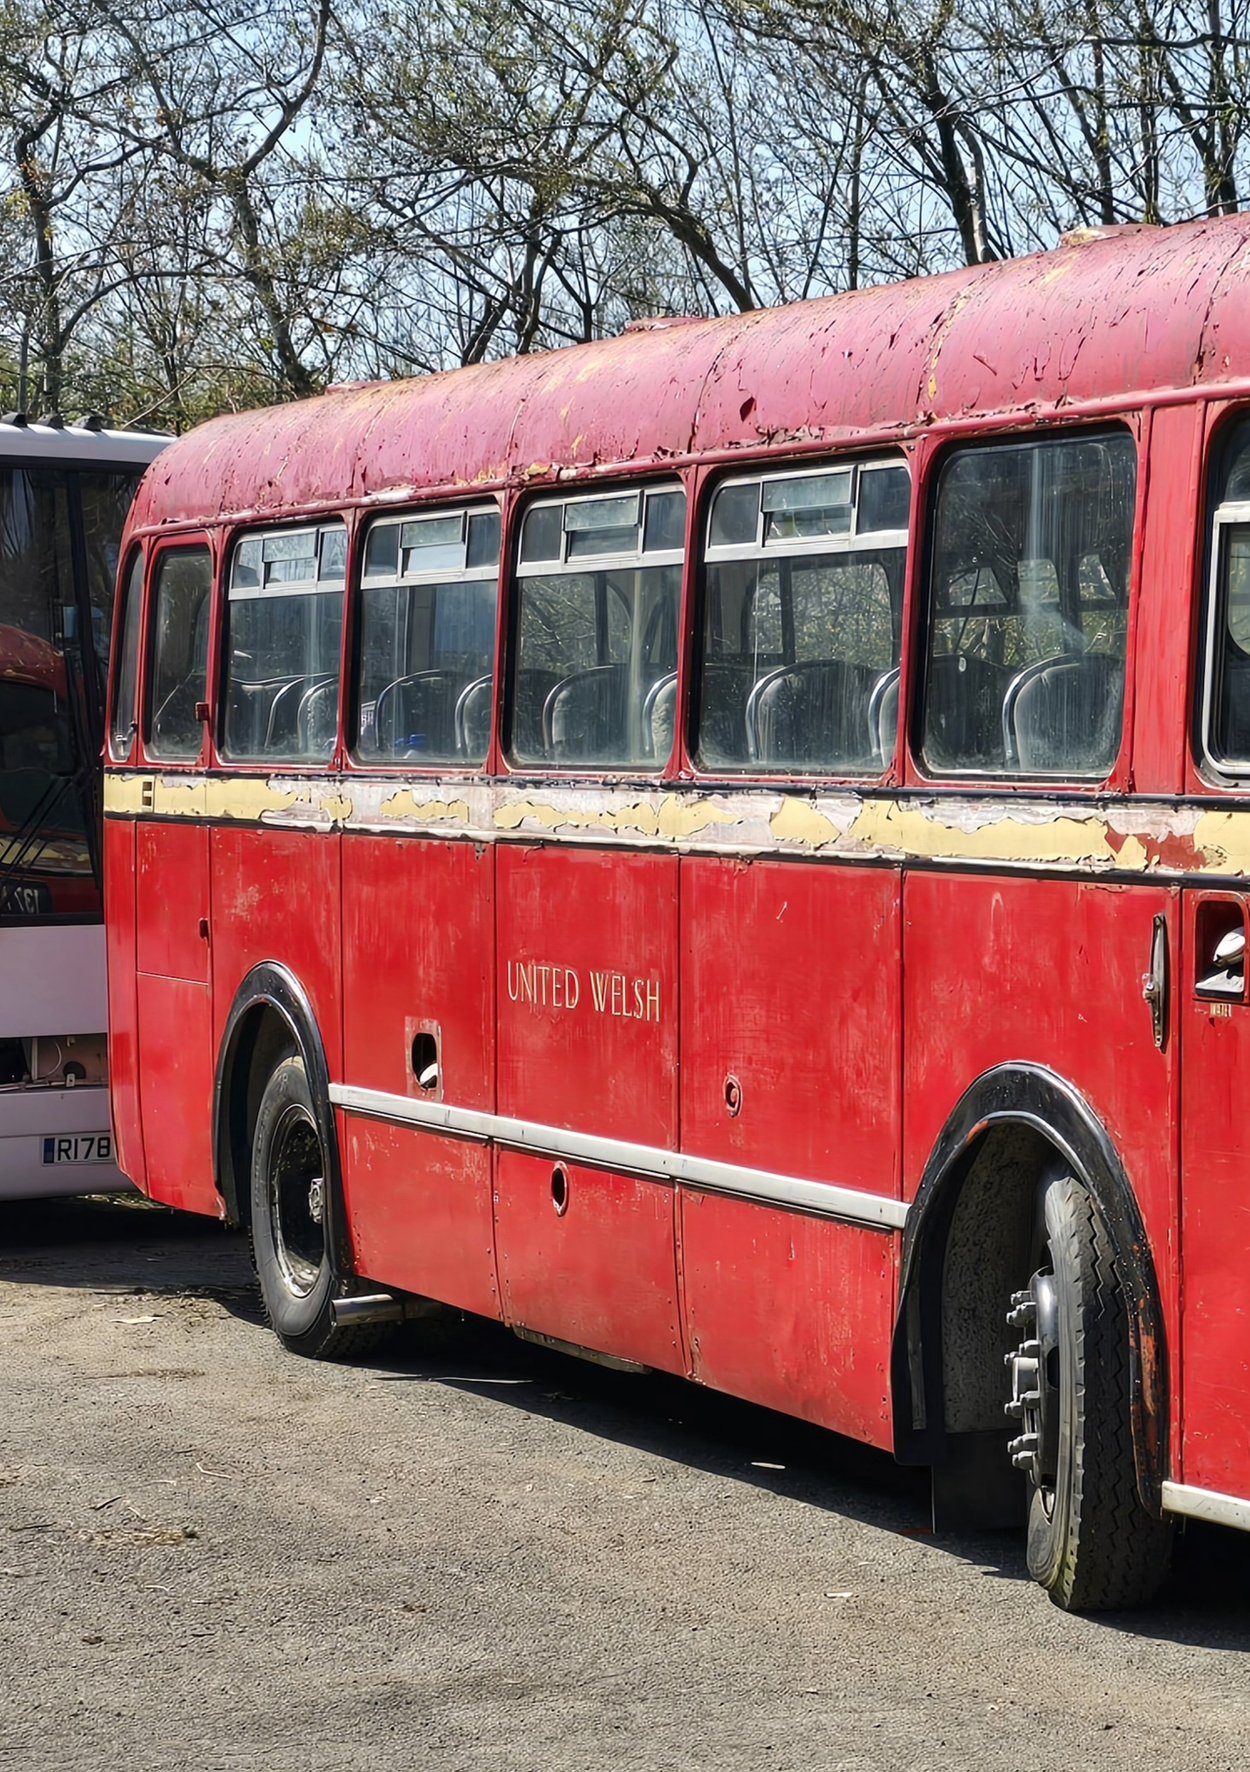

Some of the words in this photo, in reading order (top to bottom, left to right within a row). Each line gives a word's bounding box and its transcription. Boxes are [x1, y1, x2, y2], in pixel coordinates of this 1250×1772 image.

[507, 960, 580, 1009] UNITED
[589, 970, 660, 1022] WELSH
[57, 1137, 111, 1161] R178
